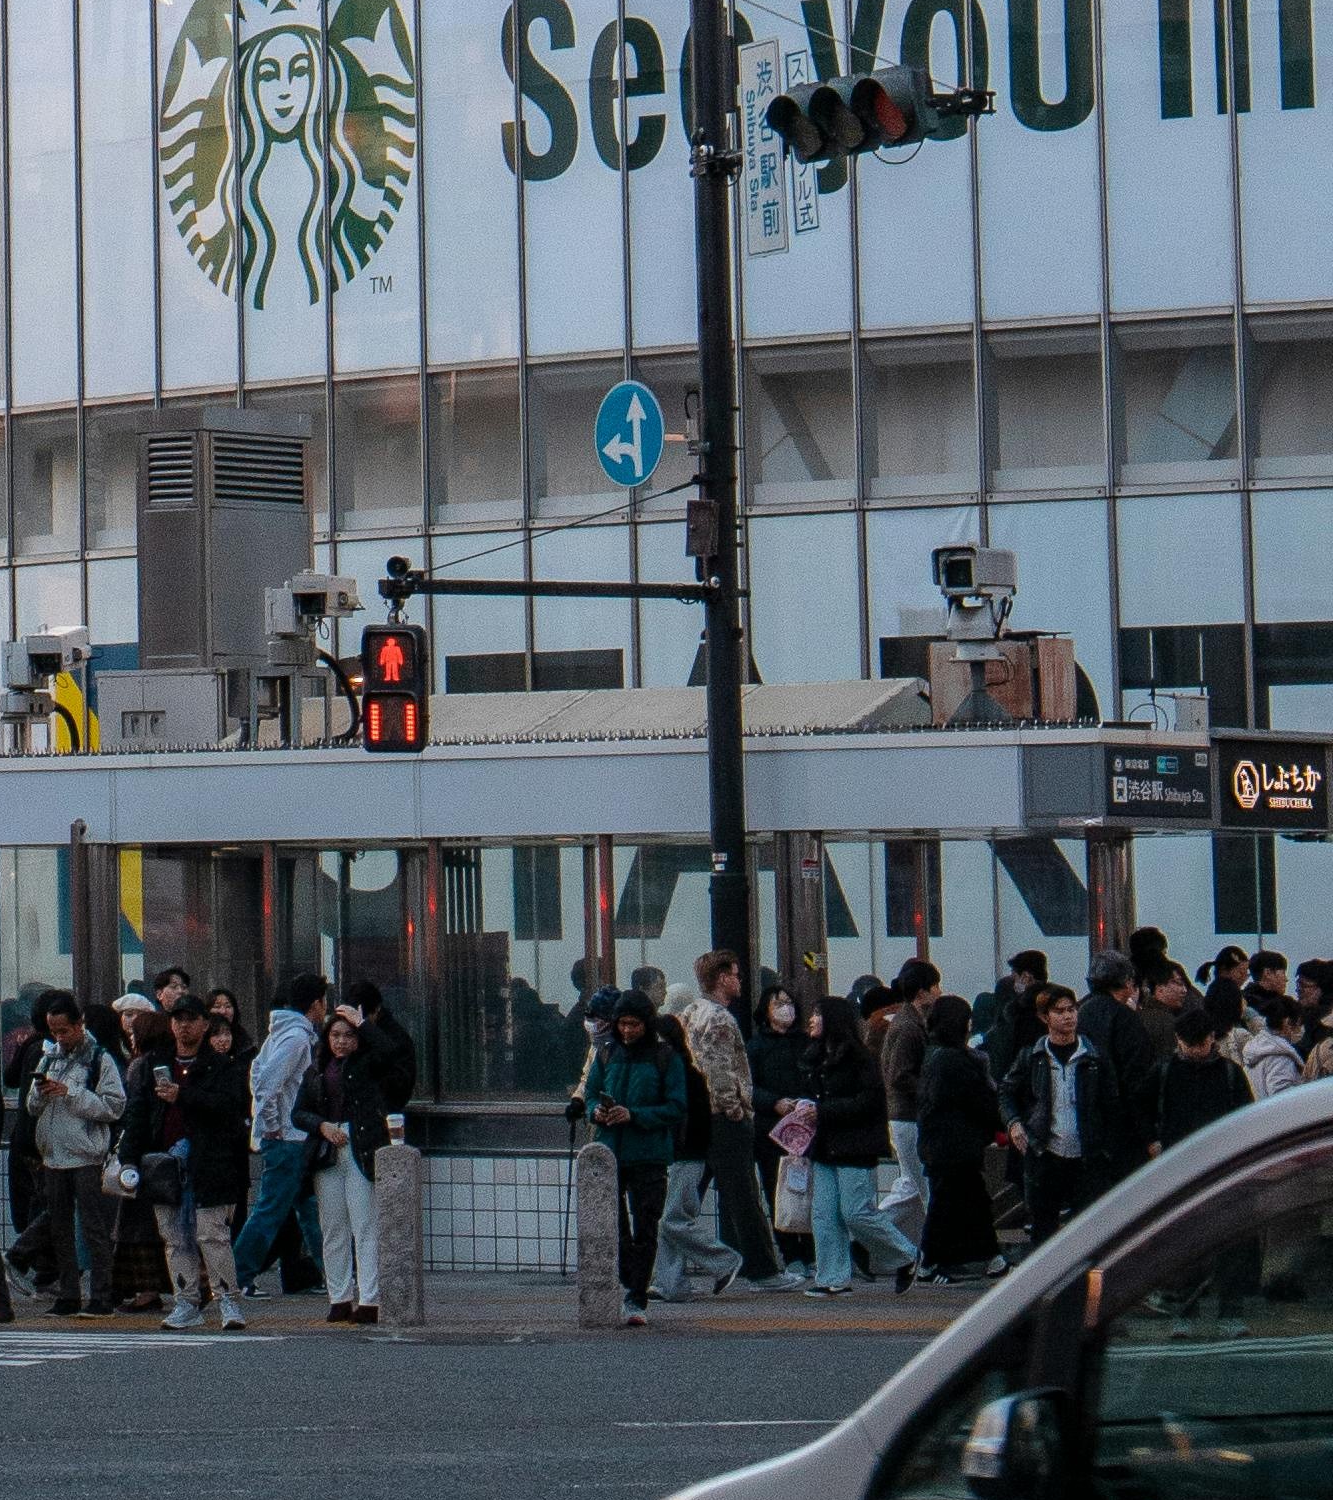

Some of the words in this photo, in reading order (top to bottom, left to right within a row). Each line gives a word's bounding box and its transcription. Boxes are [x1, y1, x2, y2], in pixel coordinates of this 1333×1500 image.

[745, 89, 758, 171] Shibuya
[749, 177, 761, 220] Sta.
[370, 275, 393, 293] TM
[1127, 779, 1164, 801] 渋谷駅
[1261, 763, 1322, 793] しぶちか
[1268, 796, 1314, 810] SHIBUCHIKA
